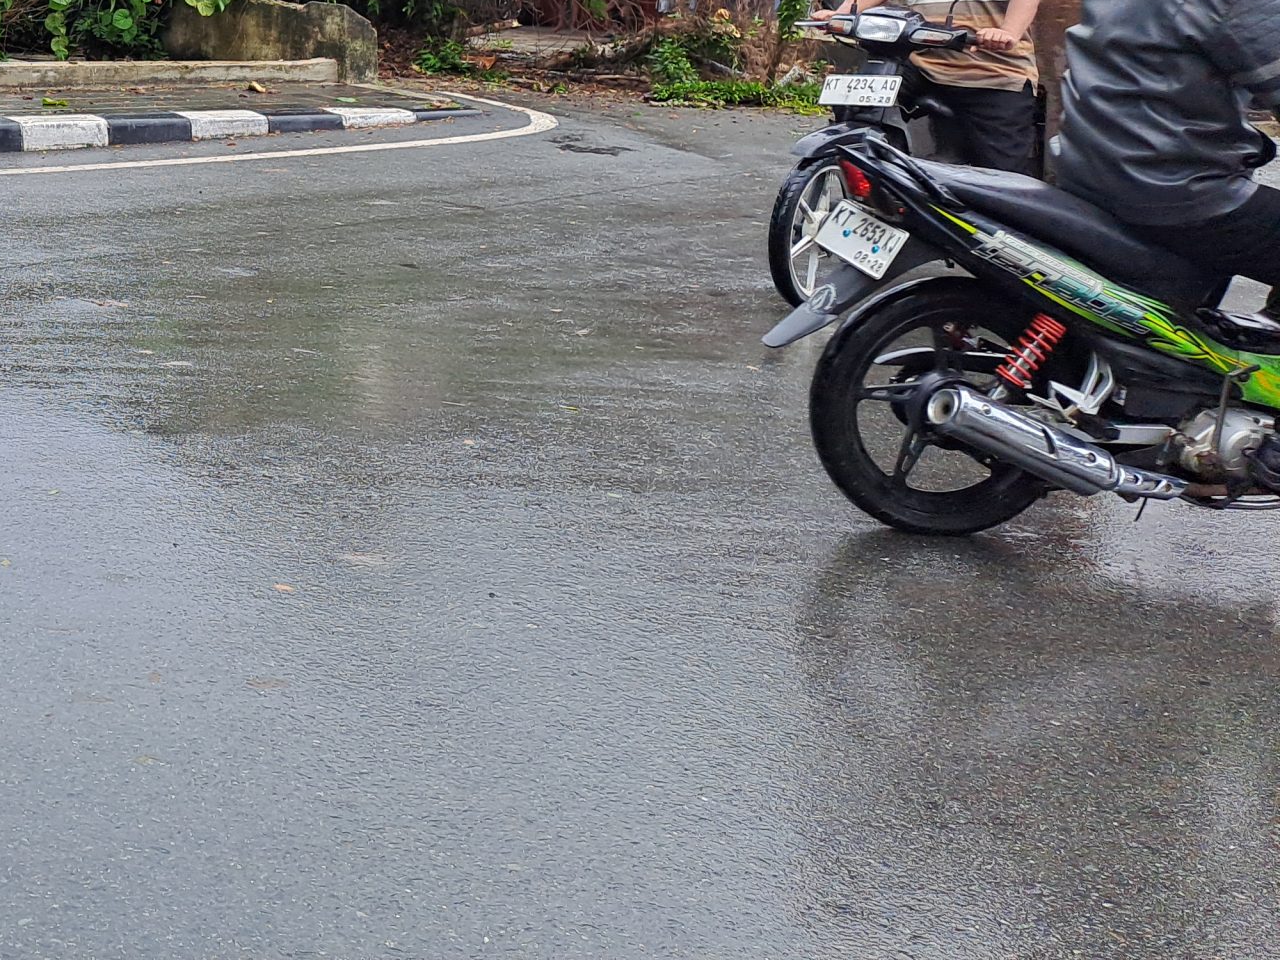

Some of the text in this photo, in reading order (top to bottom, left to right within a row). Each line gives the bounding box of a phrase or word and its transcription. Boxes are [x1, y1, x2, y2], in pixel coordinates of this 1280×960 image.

[824, 78, 841, 91] KT
[846, 78, 876, 94] 4234
[831, 205, 902, 253] KT 2653 KJ
